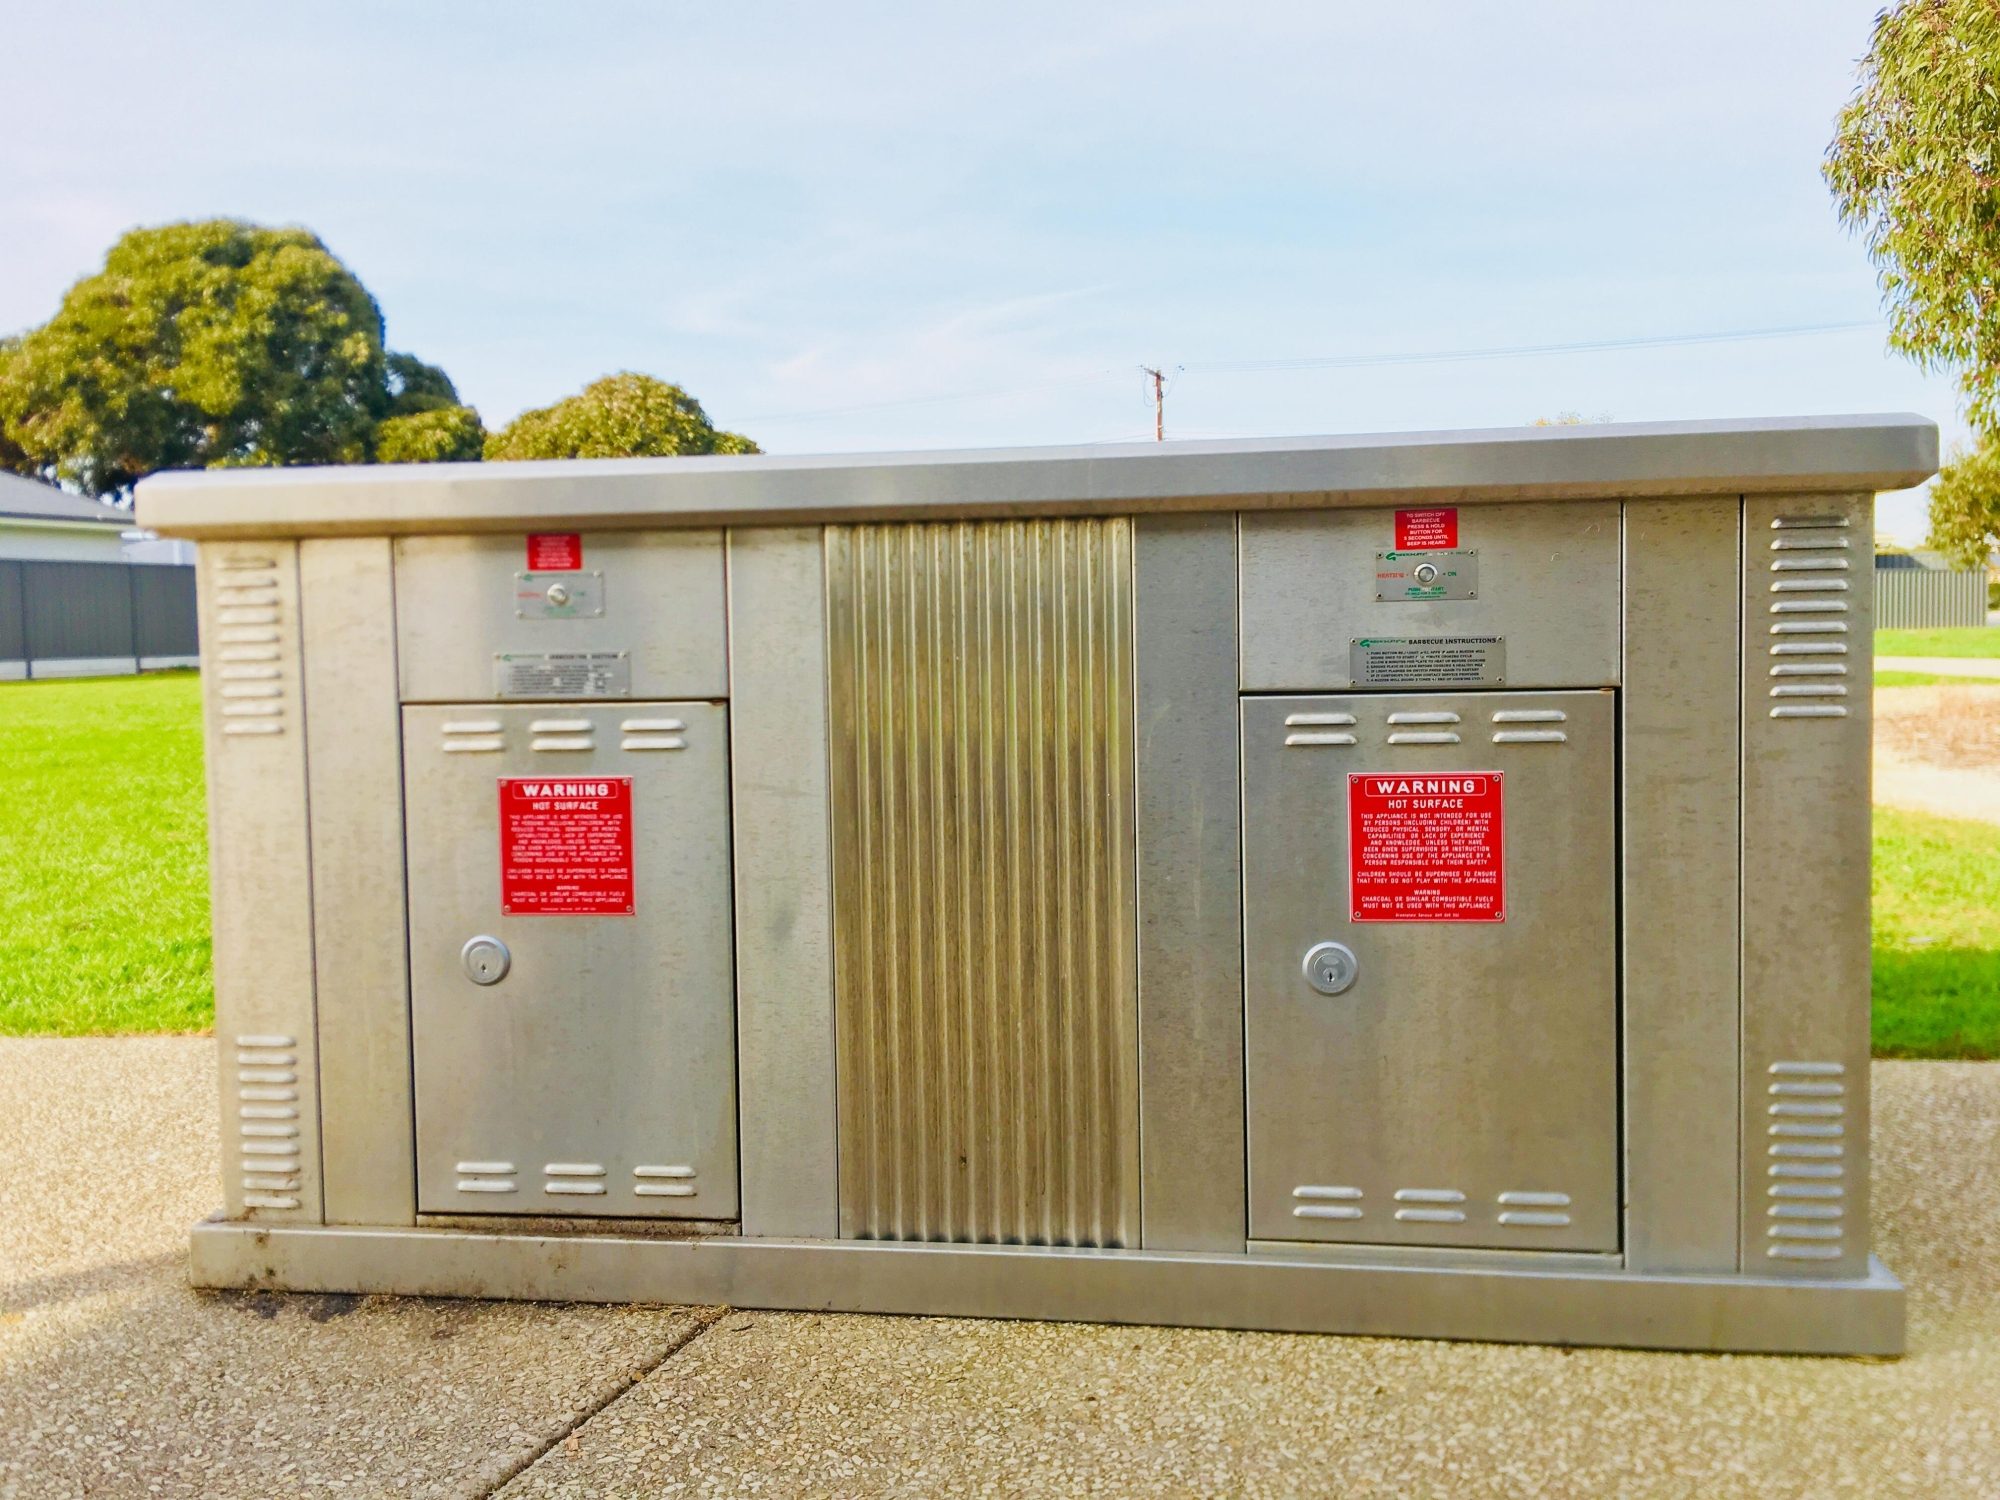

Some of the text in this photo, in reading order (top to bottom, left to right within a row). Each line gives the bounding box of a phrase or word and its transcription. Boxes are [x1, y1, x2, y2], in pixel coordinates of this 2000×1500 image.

[522, 784, 608, 796] WARNING
[1376, 780, 1476, 794] WARNING
[532, 802, 599, 810] HOT SURFACE
[1388, 799, 1463, 809] HOT SURFACE
